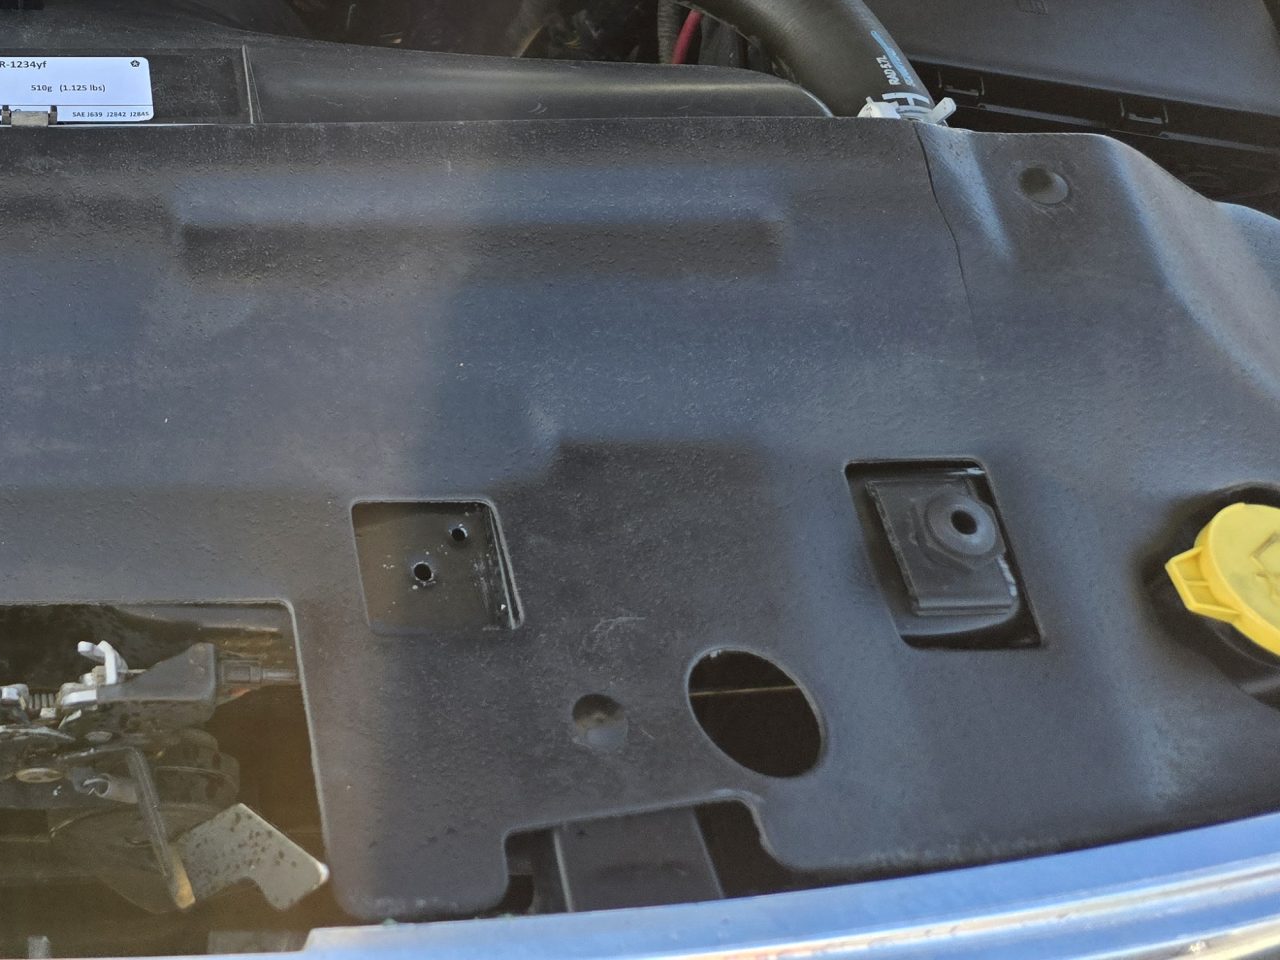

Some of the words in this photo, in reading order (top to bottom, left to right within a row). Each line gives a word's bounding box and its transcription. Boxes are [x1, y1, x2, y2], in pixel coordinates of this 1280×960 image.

[884, 69, 901, 85] RAD
[31, 85, 52, 93] 510g
[59, 84, 88, 93] (1.125
[89, 84, 106, 93] lbs)
